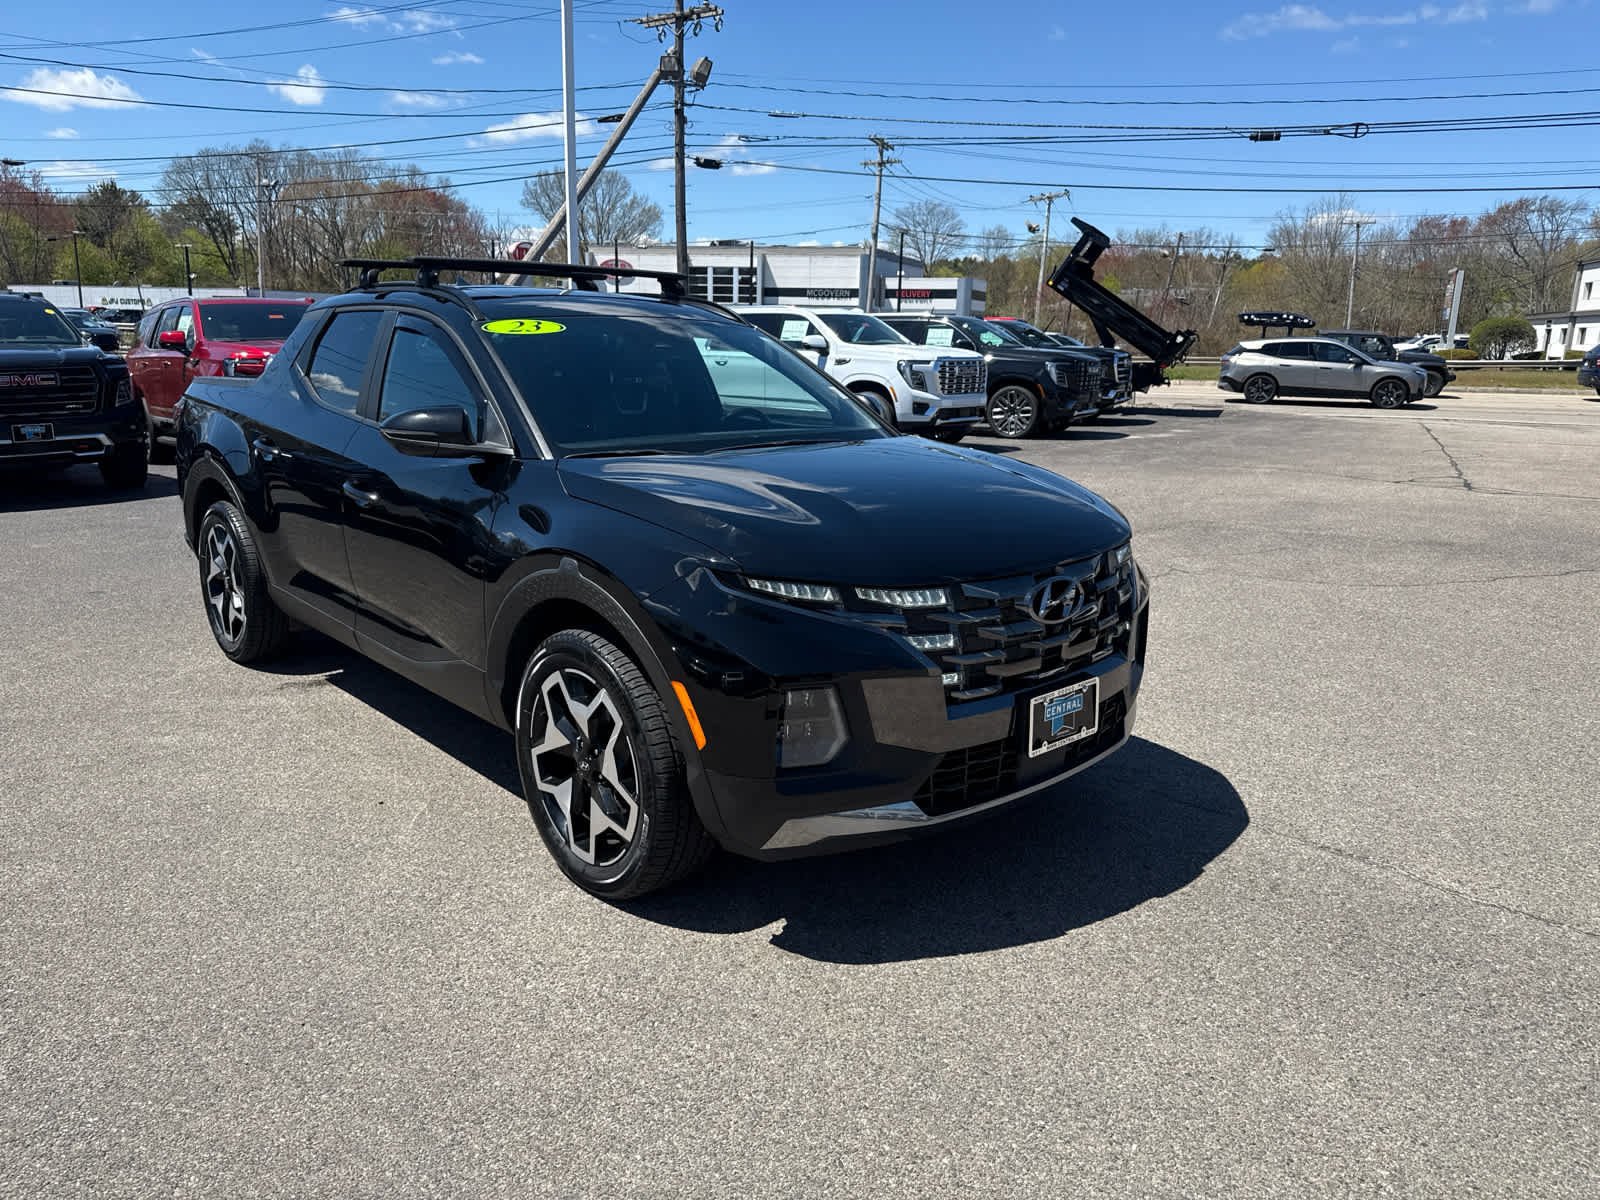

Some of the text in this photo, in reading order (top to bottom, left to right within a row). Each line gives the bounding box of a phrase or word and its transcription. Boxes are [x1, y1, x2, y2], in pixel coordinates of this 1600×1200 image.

[806, 290, 850, 298] MCGOVERN
[509, 321, 543, 332] 23
[1046, 697, 1083, 718] CENTRAL
